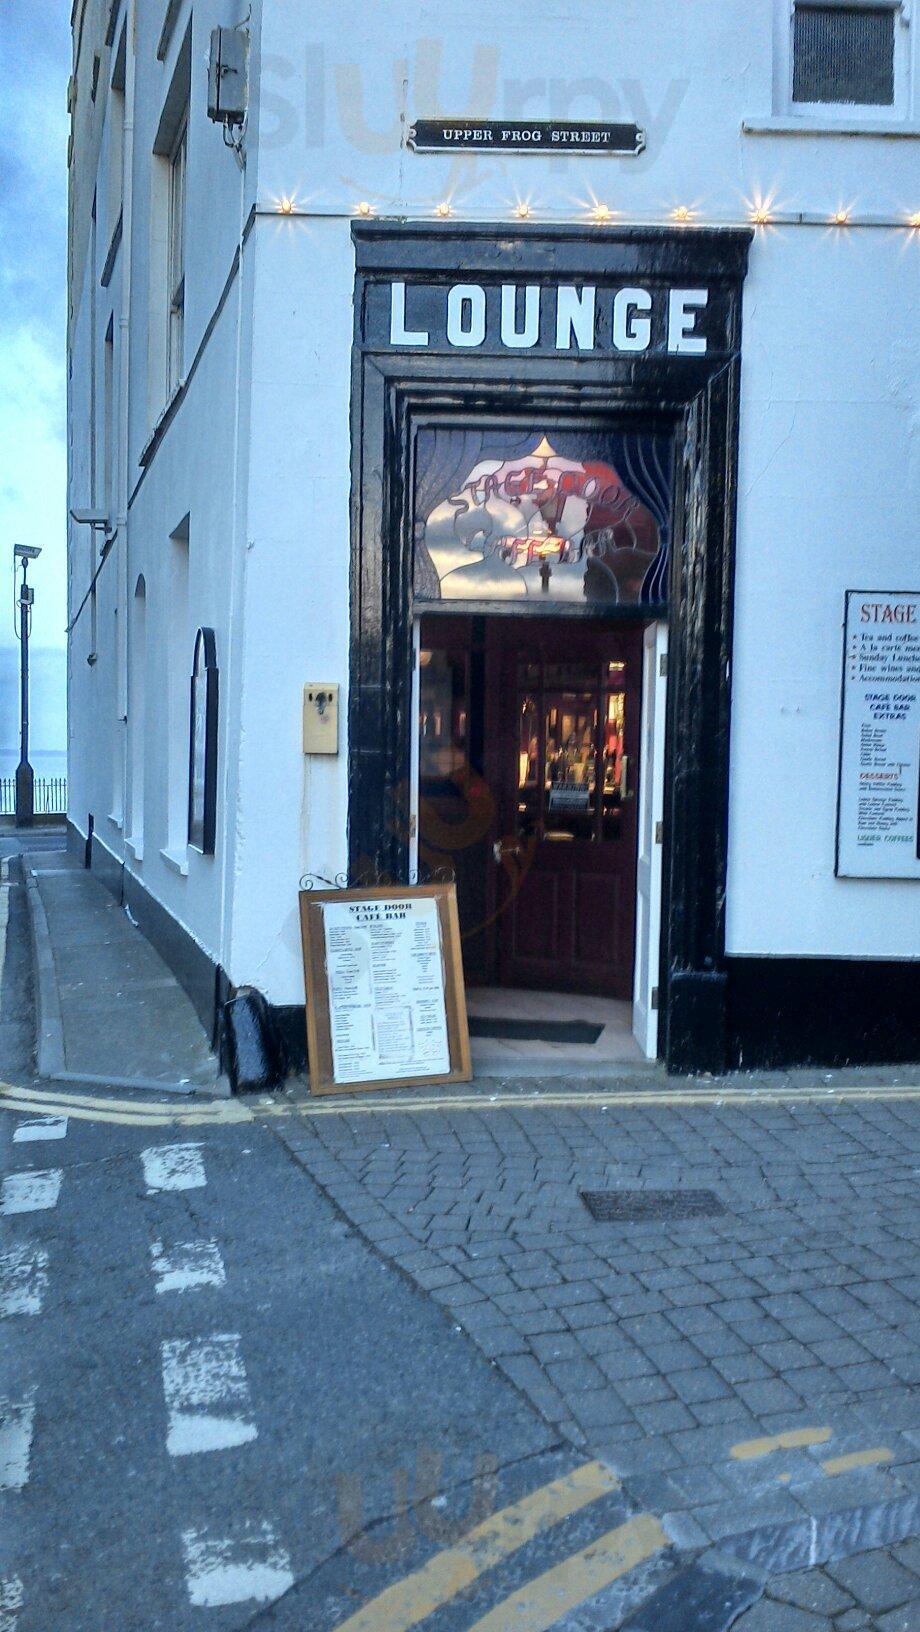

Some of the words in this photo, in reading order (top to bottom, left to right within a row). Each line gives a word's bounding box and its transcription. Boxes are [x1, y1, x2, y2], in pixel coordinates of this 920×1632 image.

[442, 129, 493, 141] UPPER
[501, 130, 542, 142] FROG
[551, 131, 610, 143] STREET
[390, 282, 709, 356] LOUNGE
[861, 604, 917, 622] STAGE
[349, 904, 379, 912] STAGE
